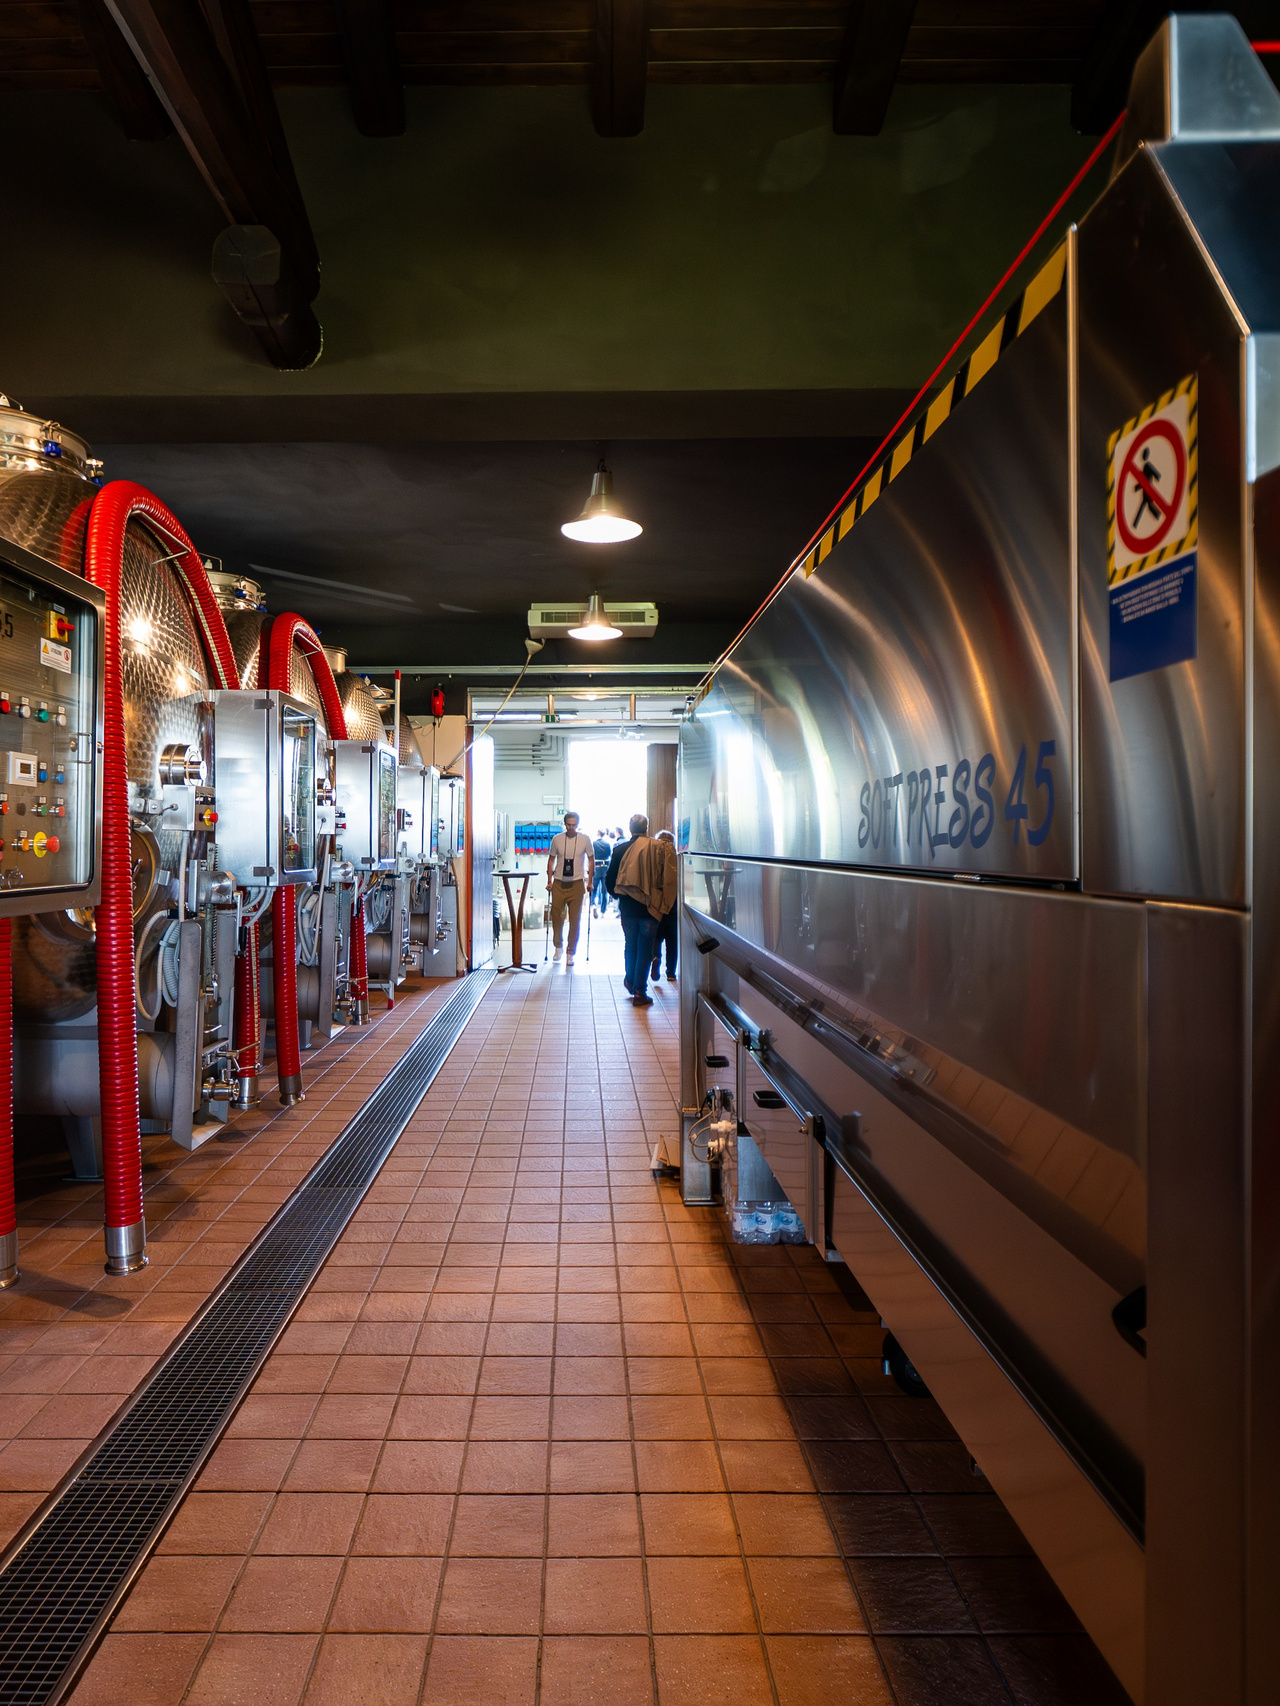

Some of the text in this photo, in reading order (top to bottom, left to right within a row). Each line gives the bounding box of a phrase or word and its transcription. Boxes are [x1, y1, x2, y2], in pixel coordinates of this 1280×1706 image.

[858, 739, 1056, 861] SOFT PRESS 45
